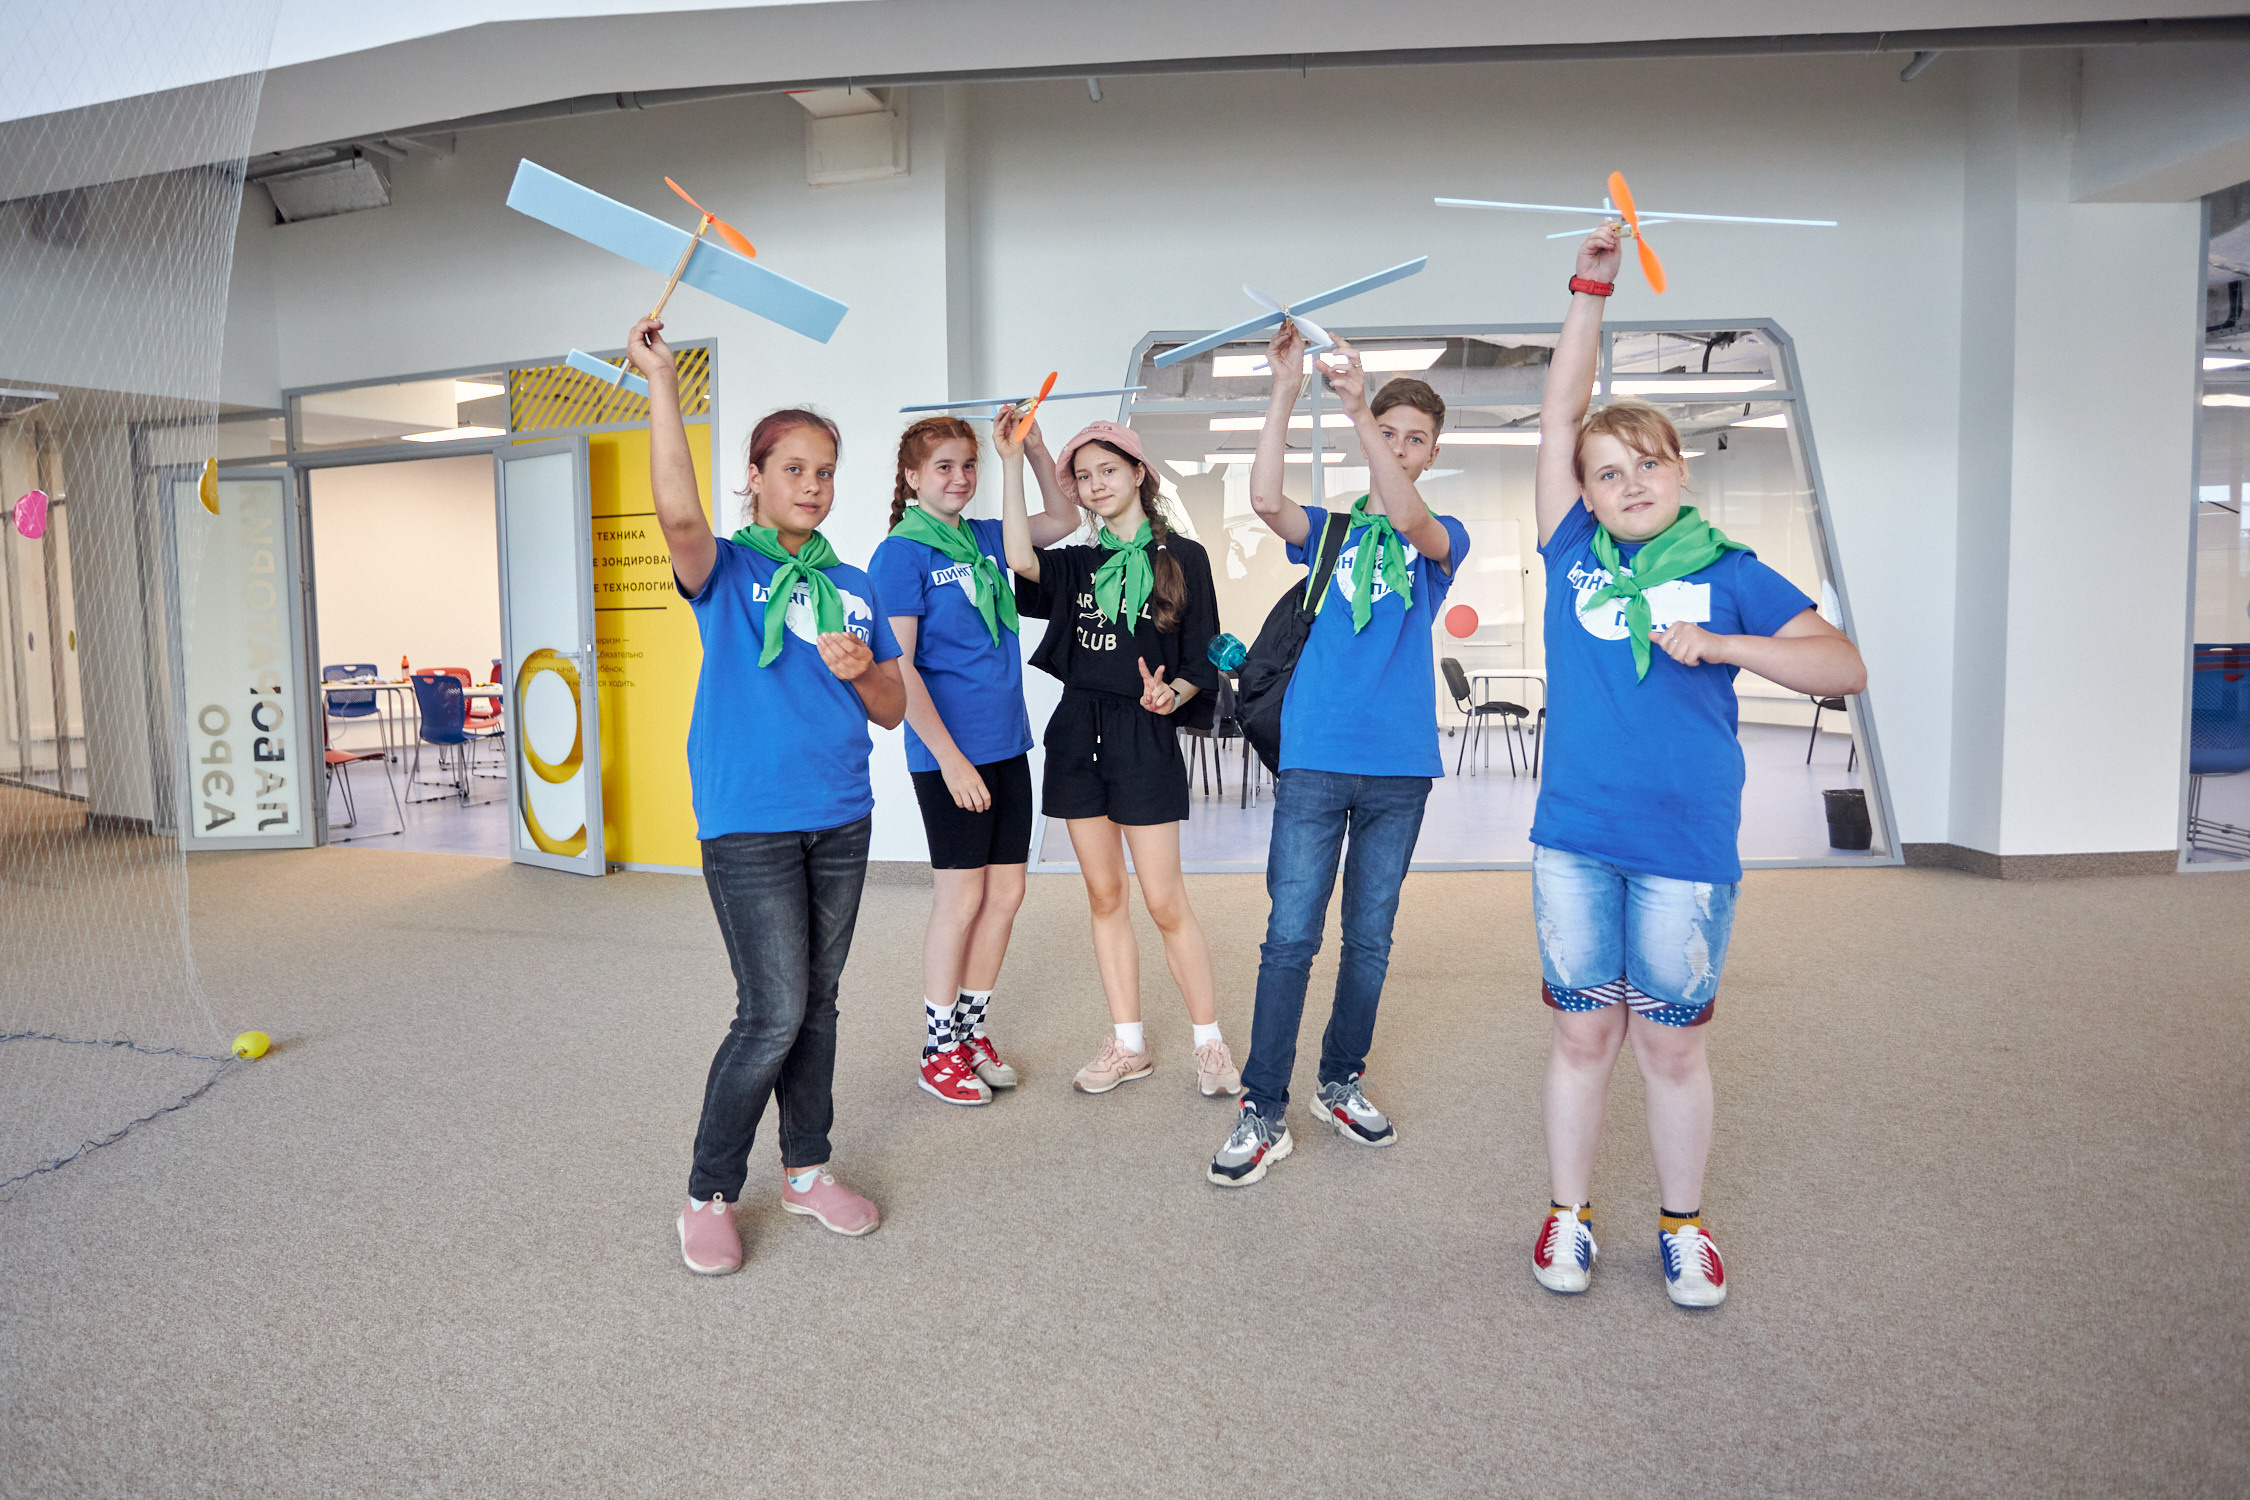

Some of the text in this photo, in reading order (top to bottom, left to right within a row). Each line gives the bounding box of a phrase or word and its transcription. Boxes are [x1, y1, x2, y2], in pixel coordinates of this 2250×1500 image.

[596, 530, 646, 541] ТЕХНИКА
[602, 581, 674, 592] ТЕХНОЛОГИИ
[1076, 626, 1117, 651] CLUB
